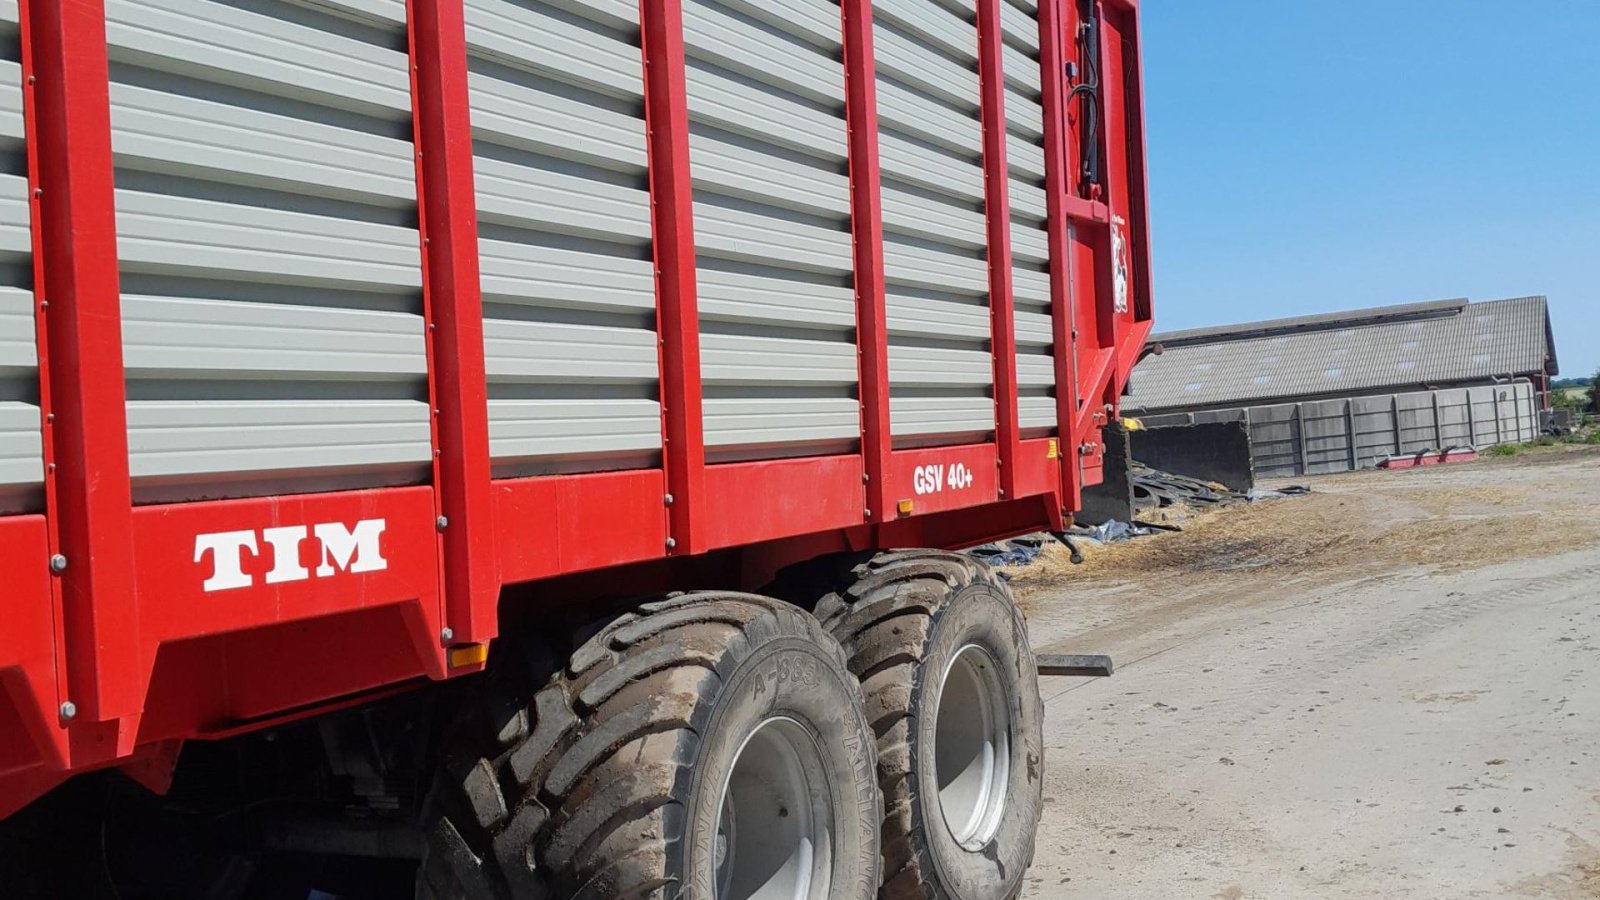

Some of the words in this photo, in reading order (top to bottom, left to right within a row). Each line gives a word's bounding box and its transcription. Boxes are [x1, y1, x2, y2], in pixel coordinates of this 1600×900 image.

[914, 464, 944, 495] GSV
[947, 462, 973, 490] 40+
[193, 518, 388, 592] TIM
